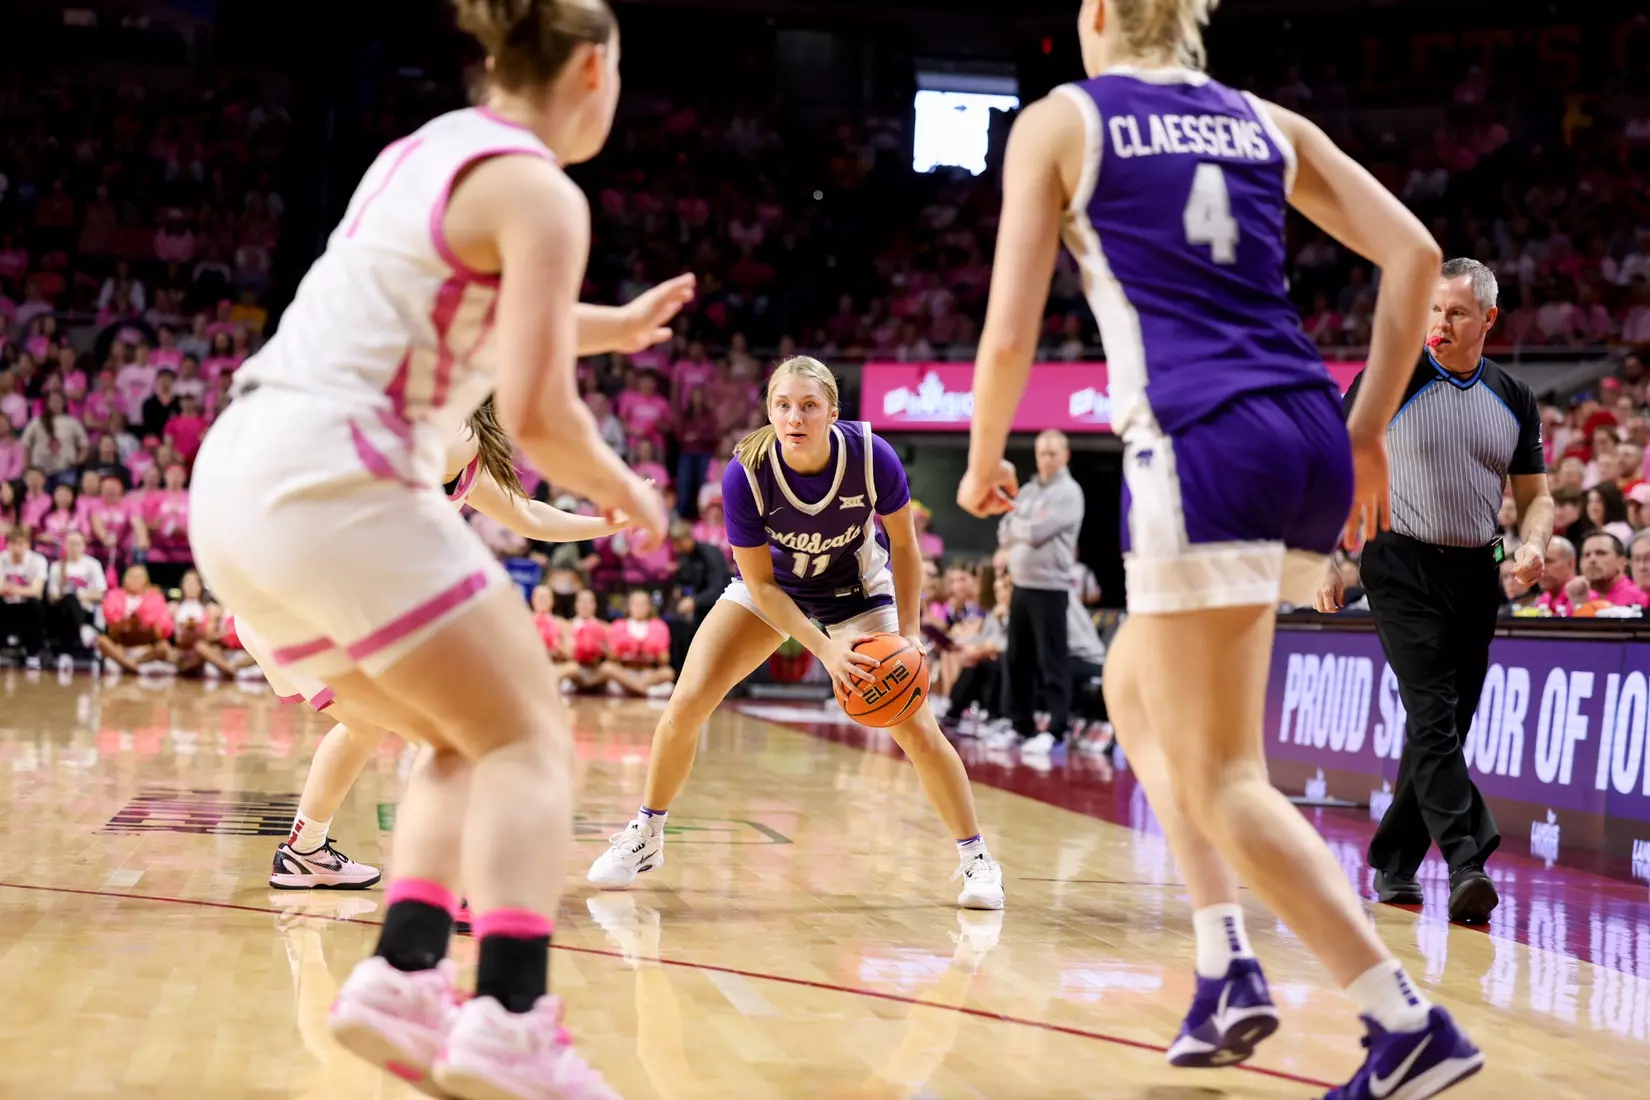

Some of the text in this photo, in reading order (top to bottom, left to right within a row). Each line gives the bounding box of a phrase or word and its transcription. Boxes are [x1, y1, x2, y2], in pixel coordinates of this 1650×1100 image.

[1108, 114, 1270, 160] CLAESSENS
[1182, 162, 1240, 264] 4
[764, 523, 860, 554] Wildcats
[791, 552, 831, 579] 11
[862, 663, 910, 705] ELITE
[1279, 652, 1374, 754] PROUD
[1534, 666, 1595, 786] OF
